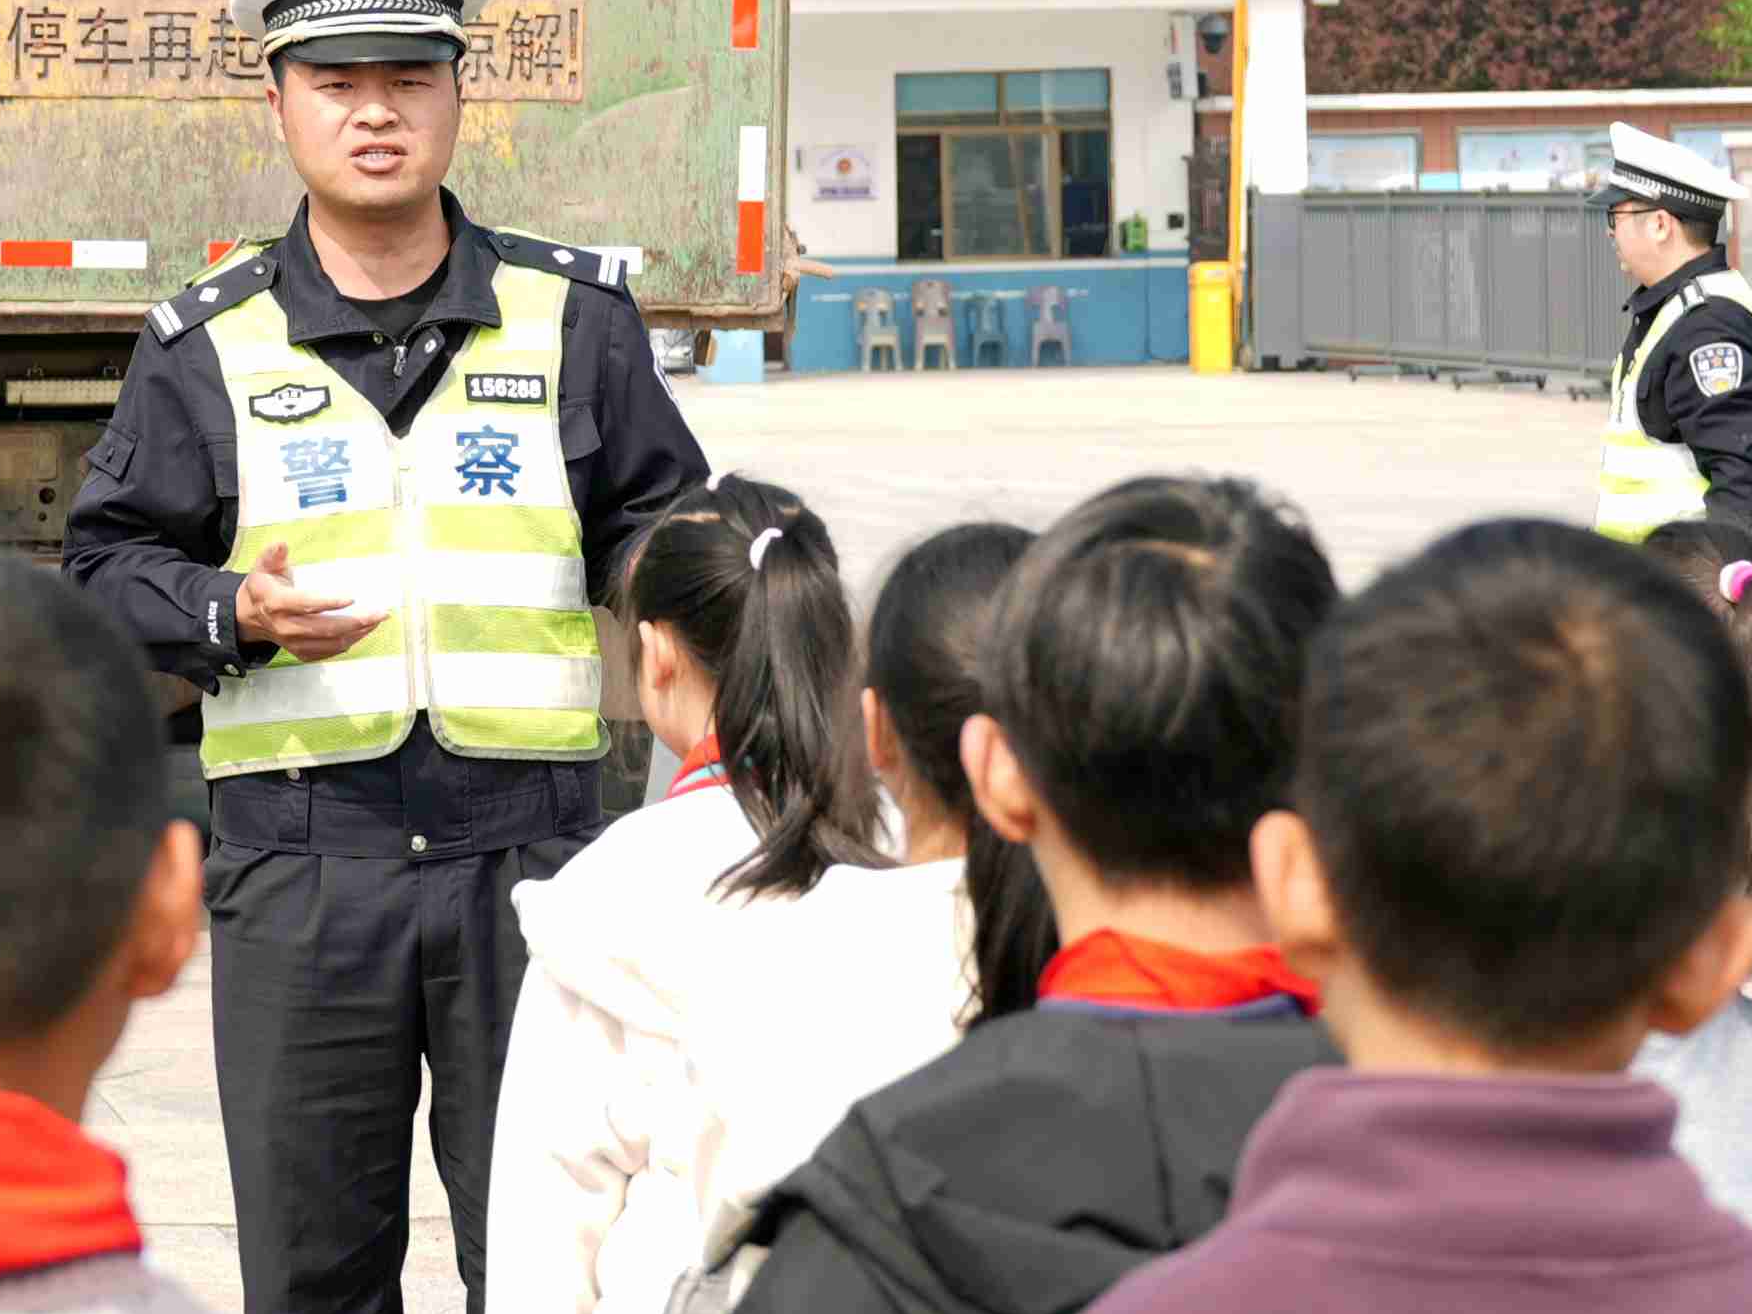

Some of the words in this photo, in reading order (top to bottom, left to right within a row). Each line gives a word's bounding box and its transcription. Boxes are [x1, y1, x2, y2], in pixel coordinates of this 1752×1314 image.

[280, 437, 352, 509] 警
[454, 424, 522, 497] 察
[207, 600, 221, 645] POLICE
